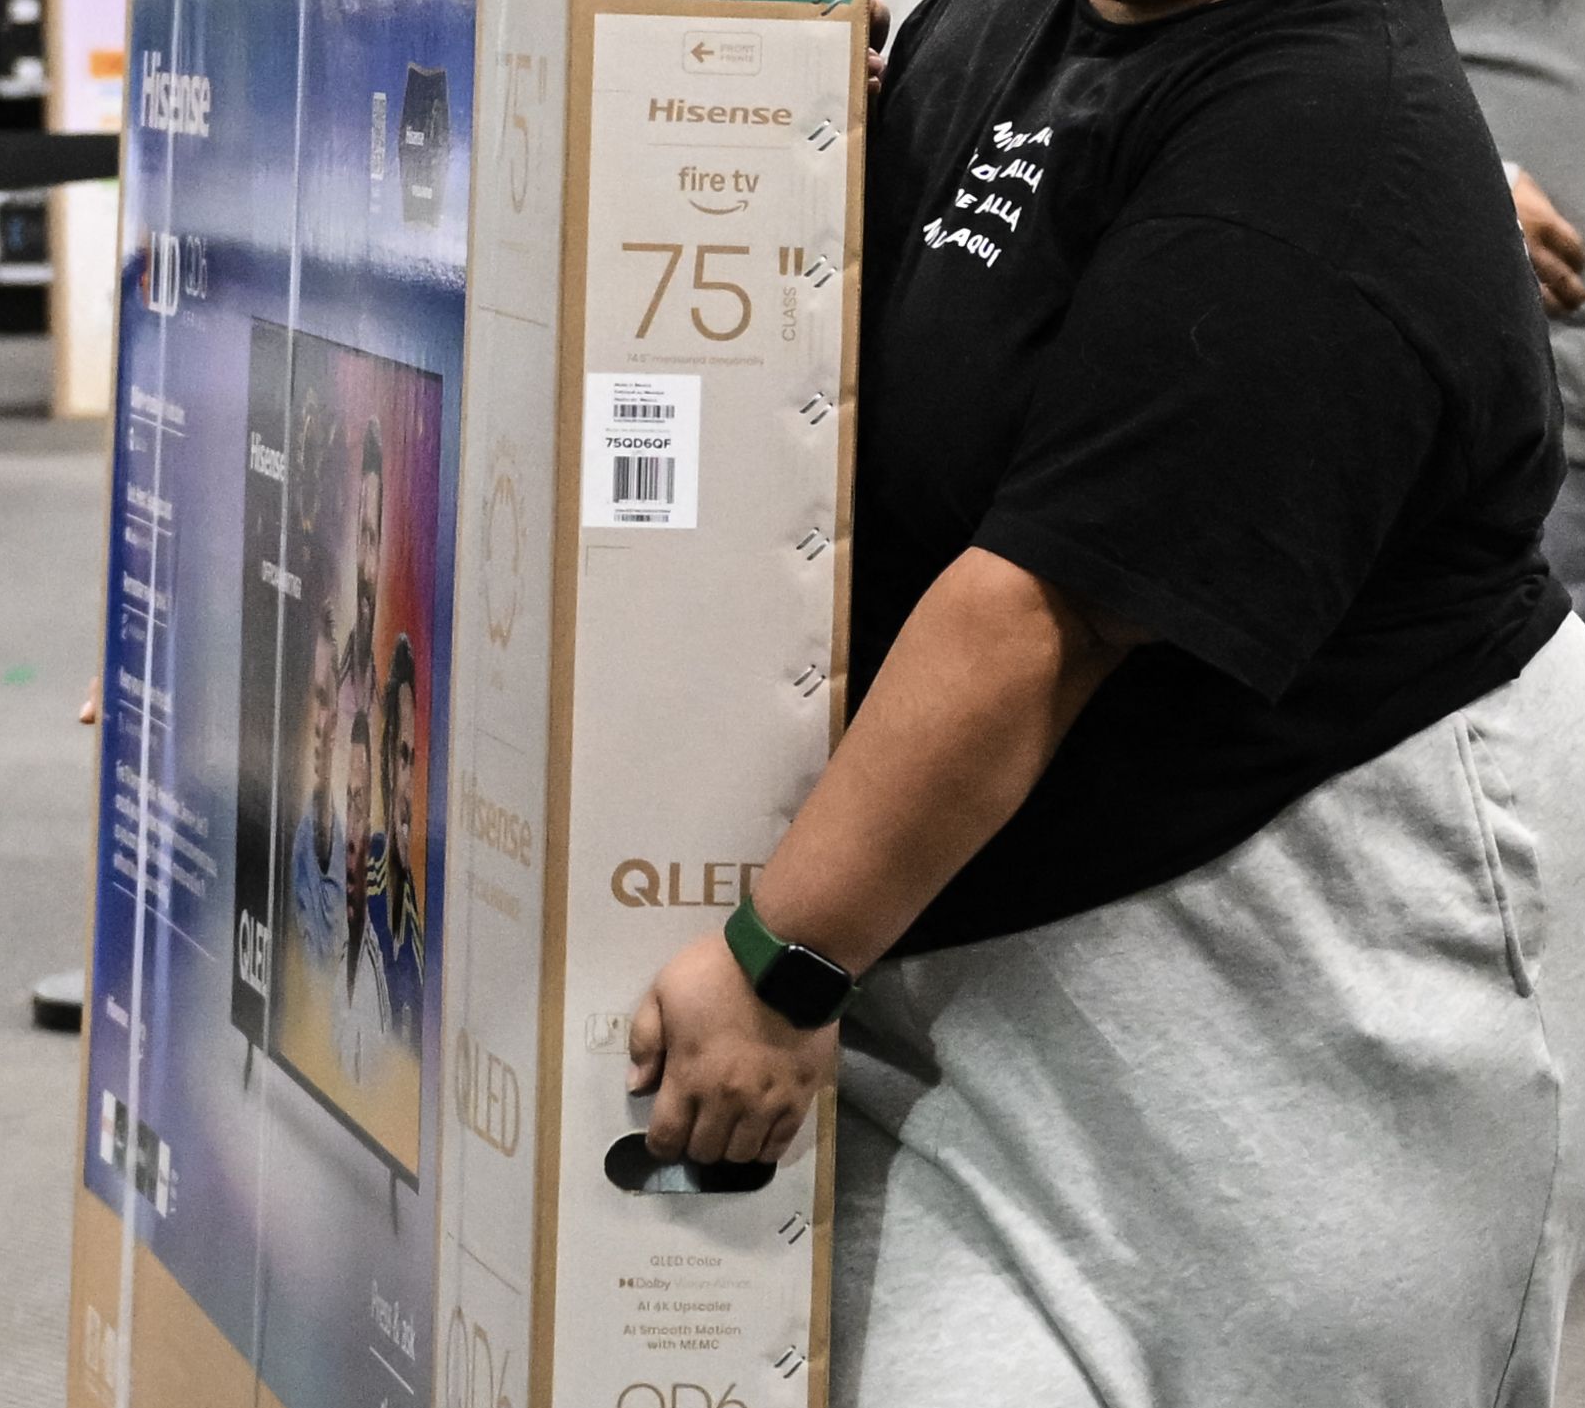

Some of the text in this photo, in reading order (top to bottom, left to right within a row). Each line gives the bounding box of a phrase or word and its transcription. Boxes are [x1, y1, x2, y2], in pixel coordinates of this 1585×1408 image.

[141, 49, 212, 138] Hisense
[647, 98, 792, 126] Hisense
[678, 165, 760, 194] fire tv
[974, 193, 1022, 232] ALLA
[781, 286, 798, 341] CLASS
[605, 437, 672, 449] 75QD6QF
[456, 1028, 520, 1158] QLED
[650, 1255, 723, 1267] QLED Color
[635, 1277, 671, 1290] Dolby
[637, 1301, 732, 1313] AI 4K Upscaler
[623, 1325, 741, 1336] AI Smooth Motion
[647, 1340, 720, 1350] with MEMC
